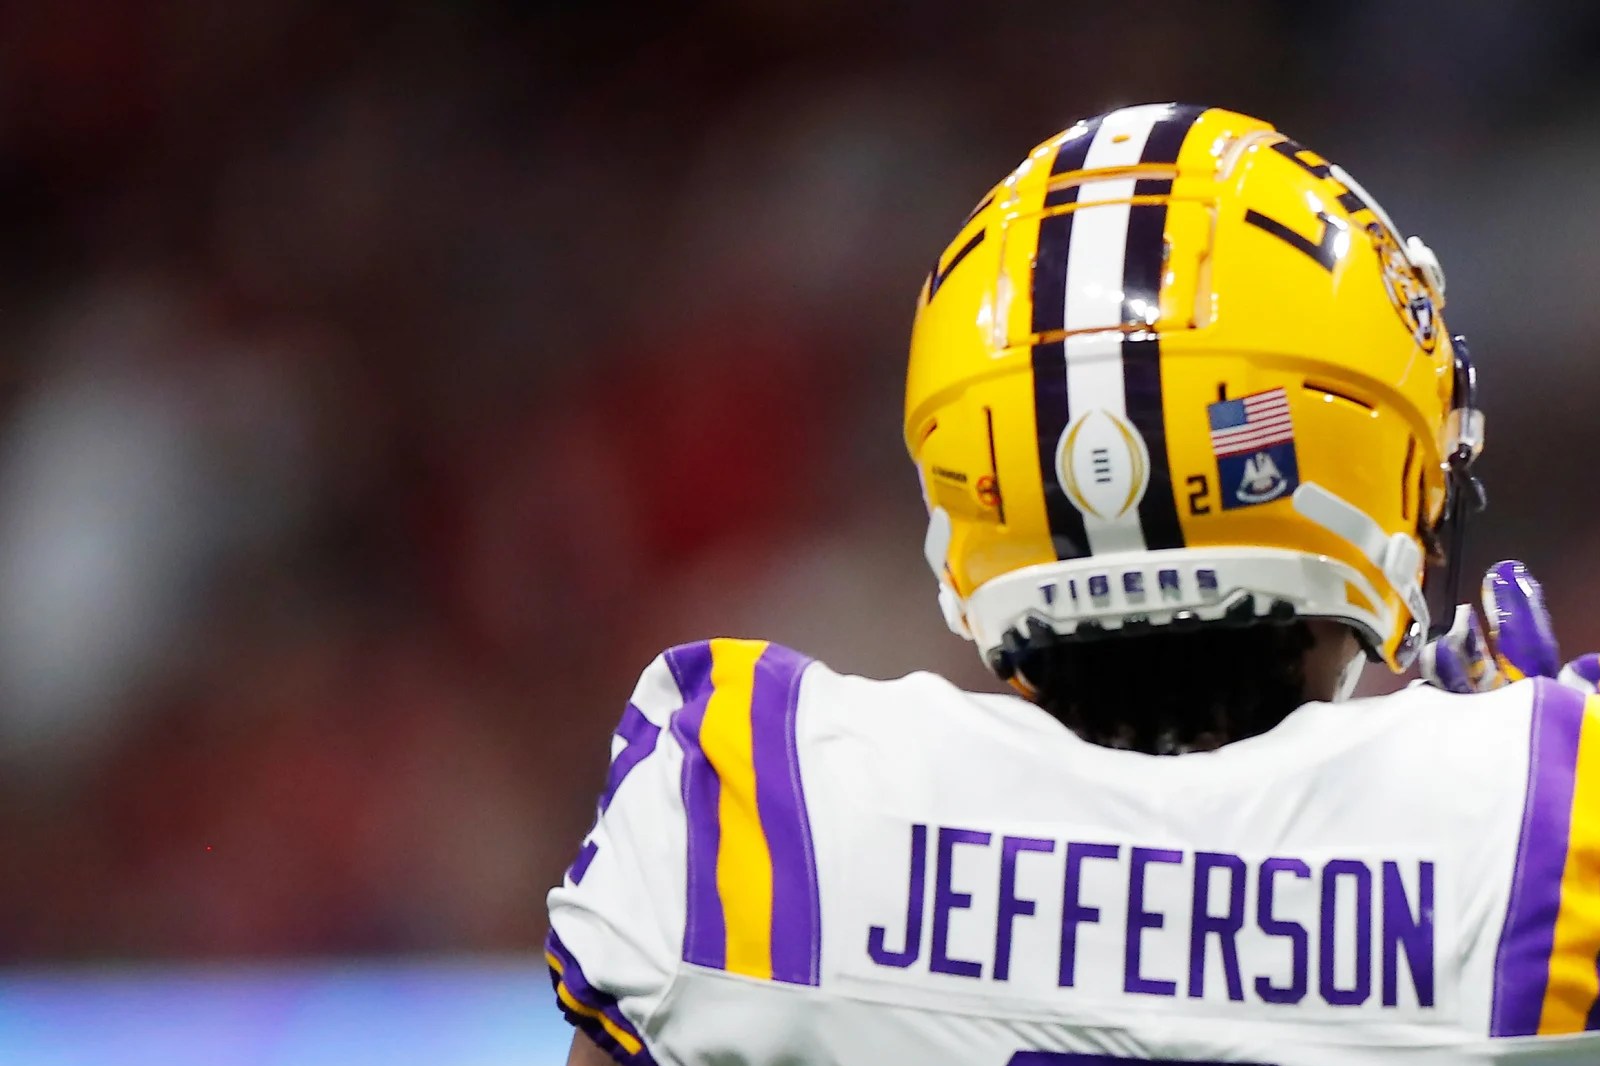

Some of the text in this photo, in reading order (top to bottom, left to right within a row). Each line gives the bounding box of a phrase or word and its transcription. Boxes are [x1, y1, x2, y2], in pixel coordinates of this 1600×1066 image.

[1186, 474, 1211, 516] 2
[1038, 568, 1219, 607] TIGERS
[866, 823, 1435, 1009] JEFFERSON
